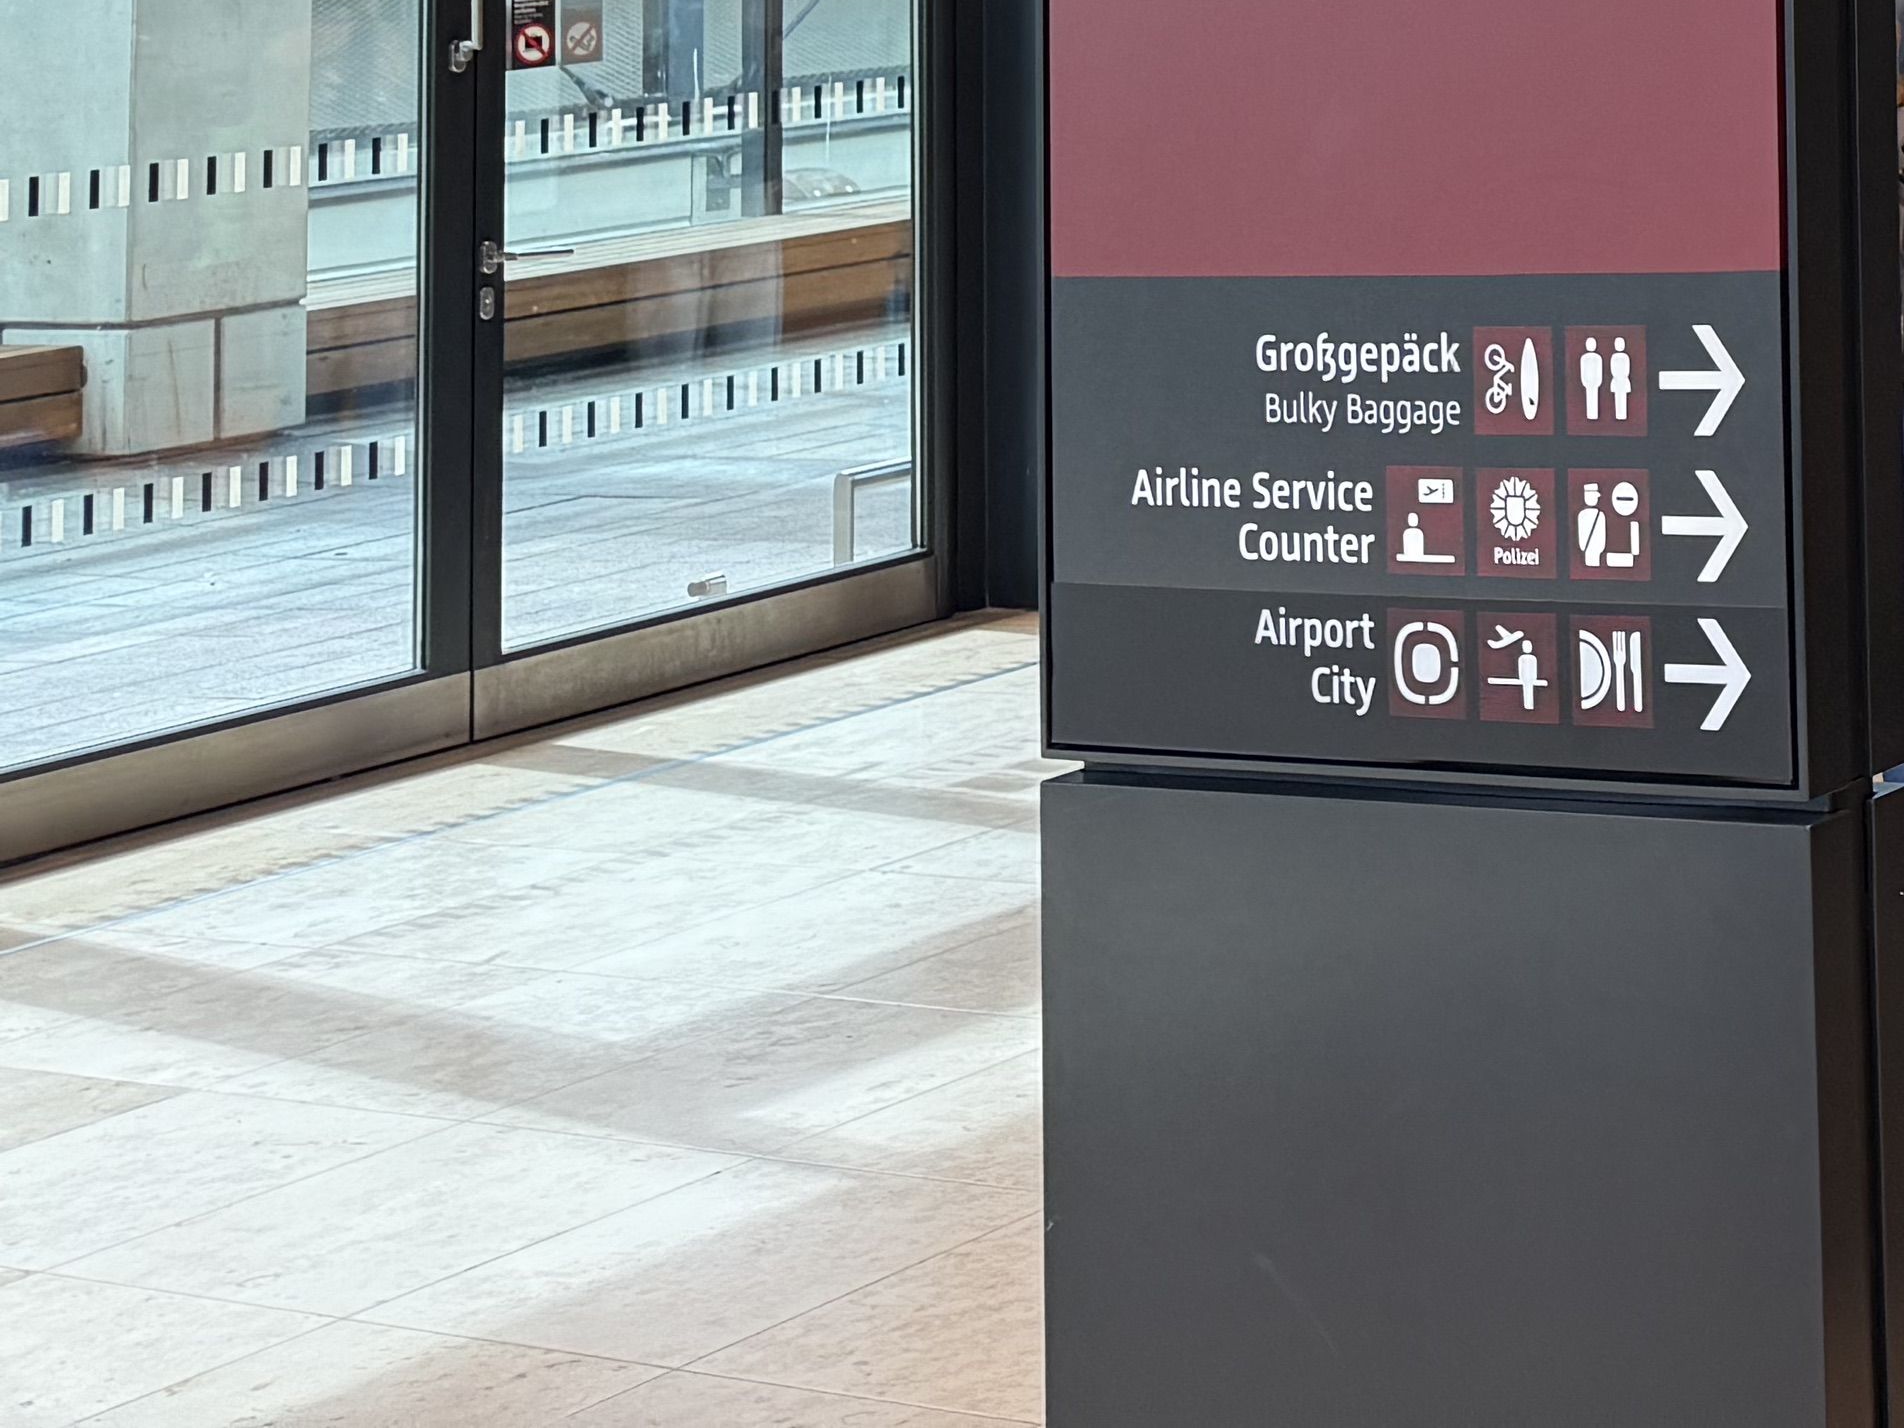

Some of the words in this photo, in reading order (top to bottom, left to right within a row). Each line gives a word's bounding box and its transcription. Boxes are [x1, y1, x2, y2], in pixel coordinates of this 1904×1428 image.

[1255, 331, 1461, 384] Großgepäck
[1265, 390, 1338, 433] Bulky
[1346, 393, 1461, 435] Baggage
[1131, 466, 1241, 509] Airline
[1252, 470, 1374, 512] Service
[1238, 522, 1376, 564] Counter
[1493, 546, 1540, 565] Polizei
[1254, 606, 1375, 658] Airport
[1311, 664, 1376, 717] City
